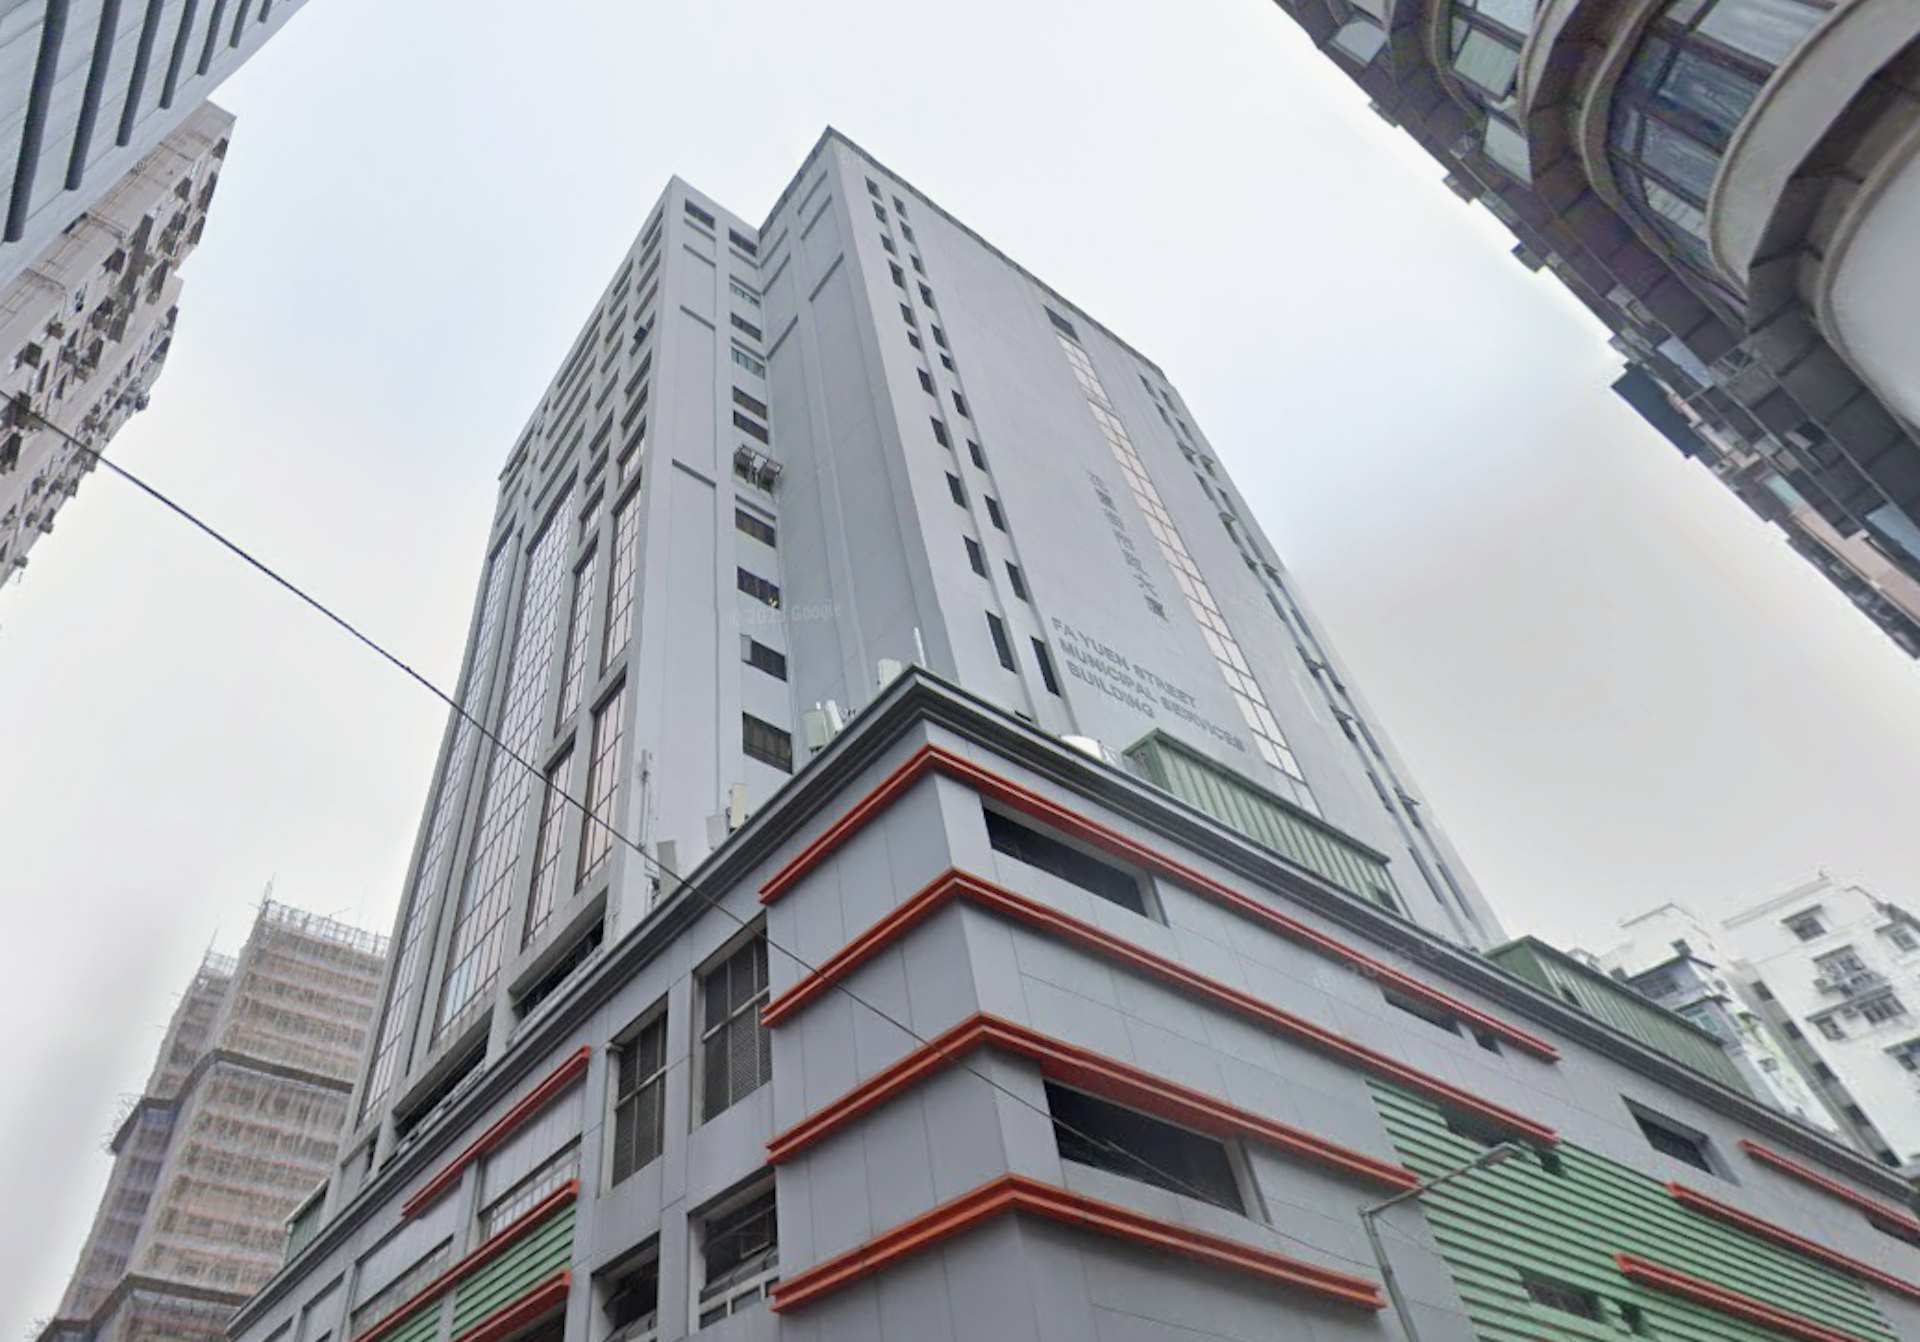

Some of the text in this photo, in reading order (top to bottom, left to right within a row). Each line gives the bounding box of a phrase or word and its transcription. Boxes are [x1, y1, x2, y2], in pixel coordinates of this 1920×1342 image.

[1051, 616, 1196, 708] FA YUEN STREET
[1059, 638, 1245, 752] MUNICIPAL SERVICES
[1066, 659, 1155, 719] BUILDING
